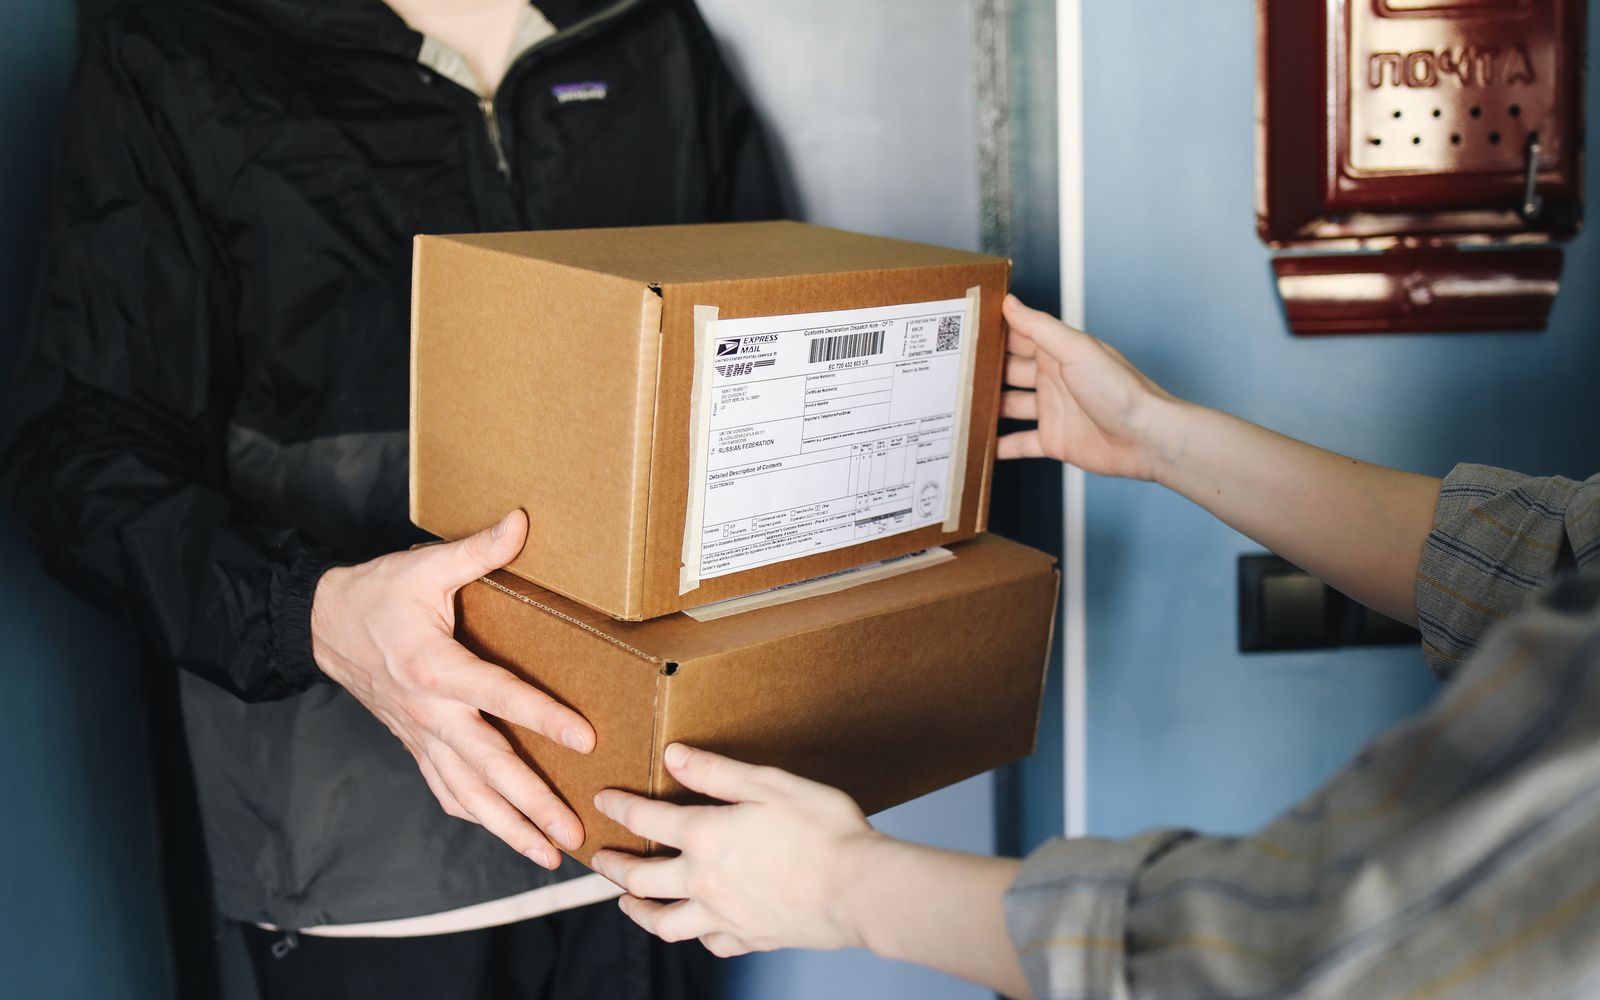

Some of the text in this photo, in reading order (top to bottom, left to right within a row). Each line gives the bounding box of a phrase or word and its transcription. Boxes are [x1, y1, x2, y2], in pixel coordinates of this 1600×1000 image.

[1369, 44, 1536, 89] ПОЧТА
[743, 335, 778, 343] EXPRESS
[740, 345, 760, 353] MAIL
[725, 361, 753, 377] EMS
[718, 444, 741, 453] RUSSIAN
[742, 438, 774, 449] FEDERATION
[709, 471, 728, 480] Detailed
[729, 466, 755, 477] Description
[762, 461, 782, 470] Contents
[709, 480, 734, 489] ELECTRONICS
